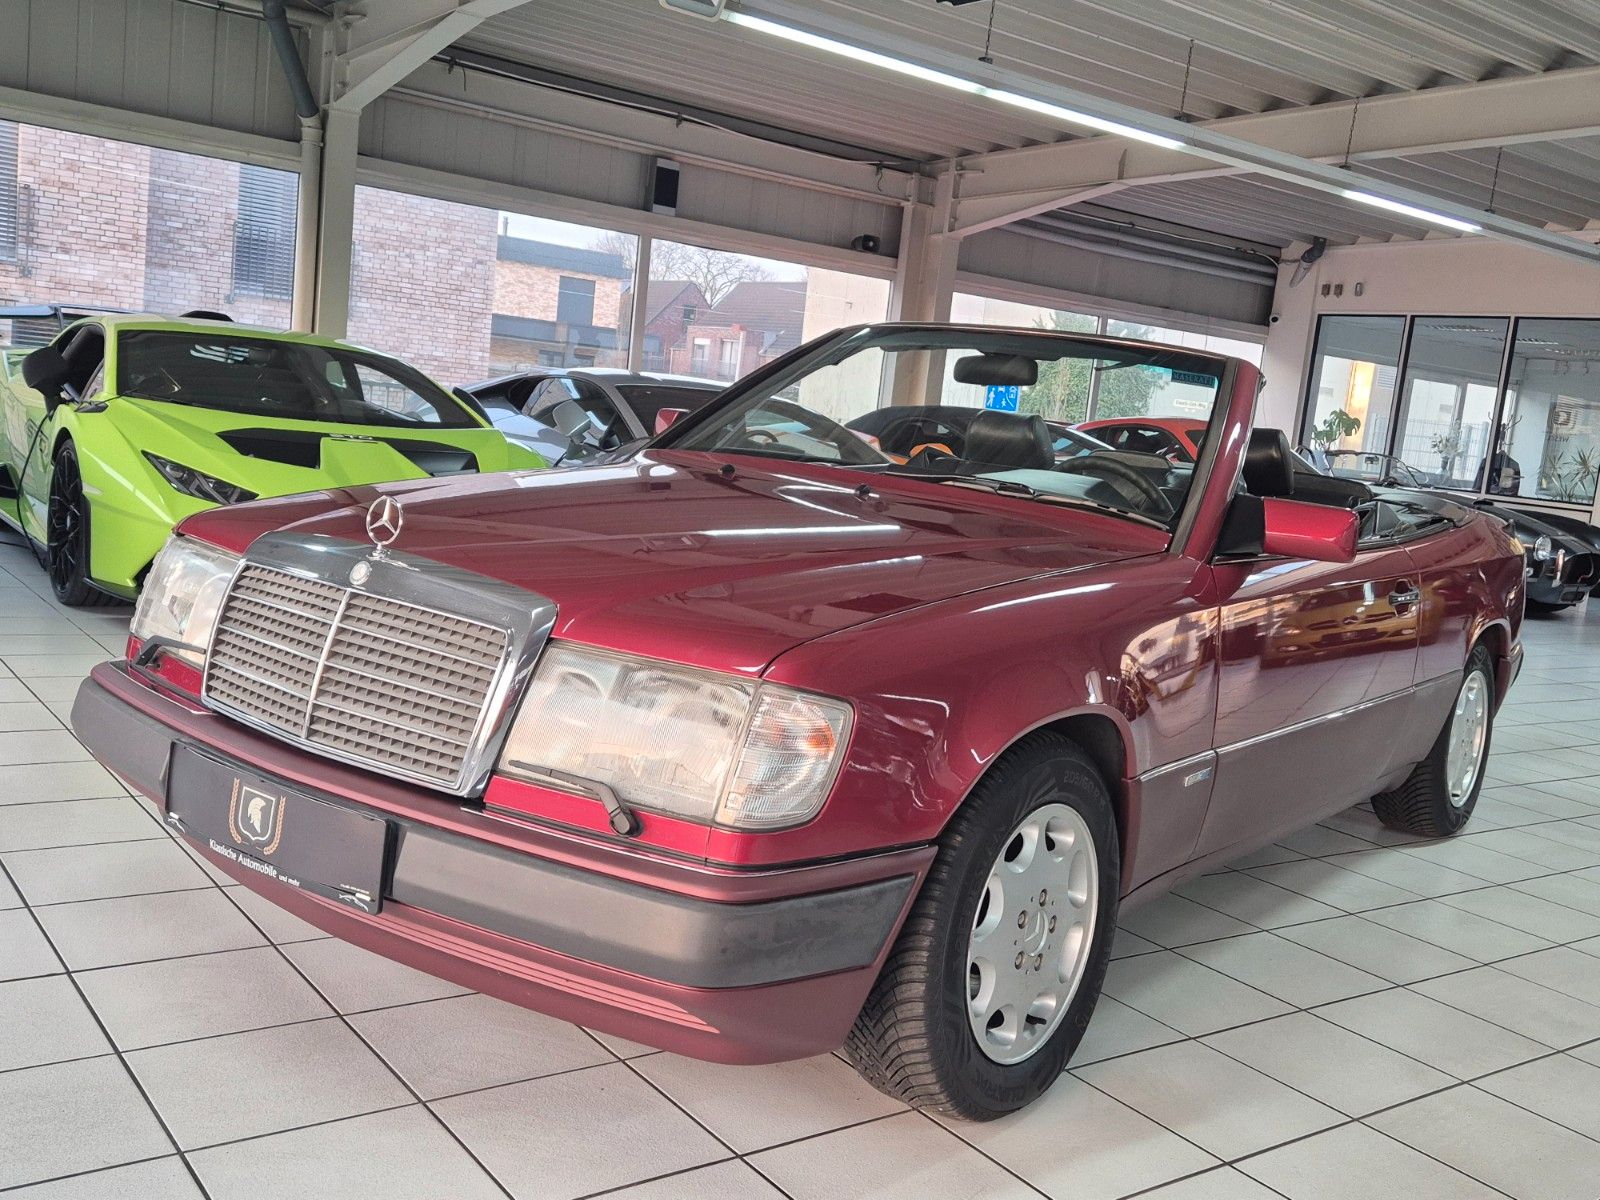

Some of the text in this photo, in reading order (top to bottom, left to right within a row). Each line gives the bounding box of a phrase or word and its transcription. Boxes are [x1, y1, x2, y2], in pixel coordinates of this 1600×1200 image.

[209, 838, 237, 861] Klassische
[238, 853, 277, 878] Automobile
[278, 874, 288, 883] und
